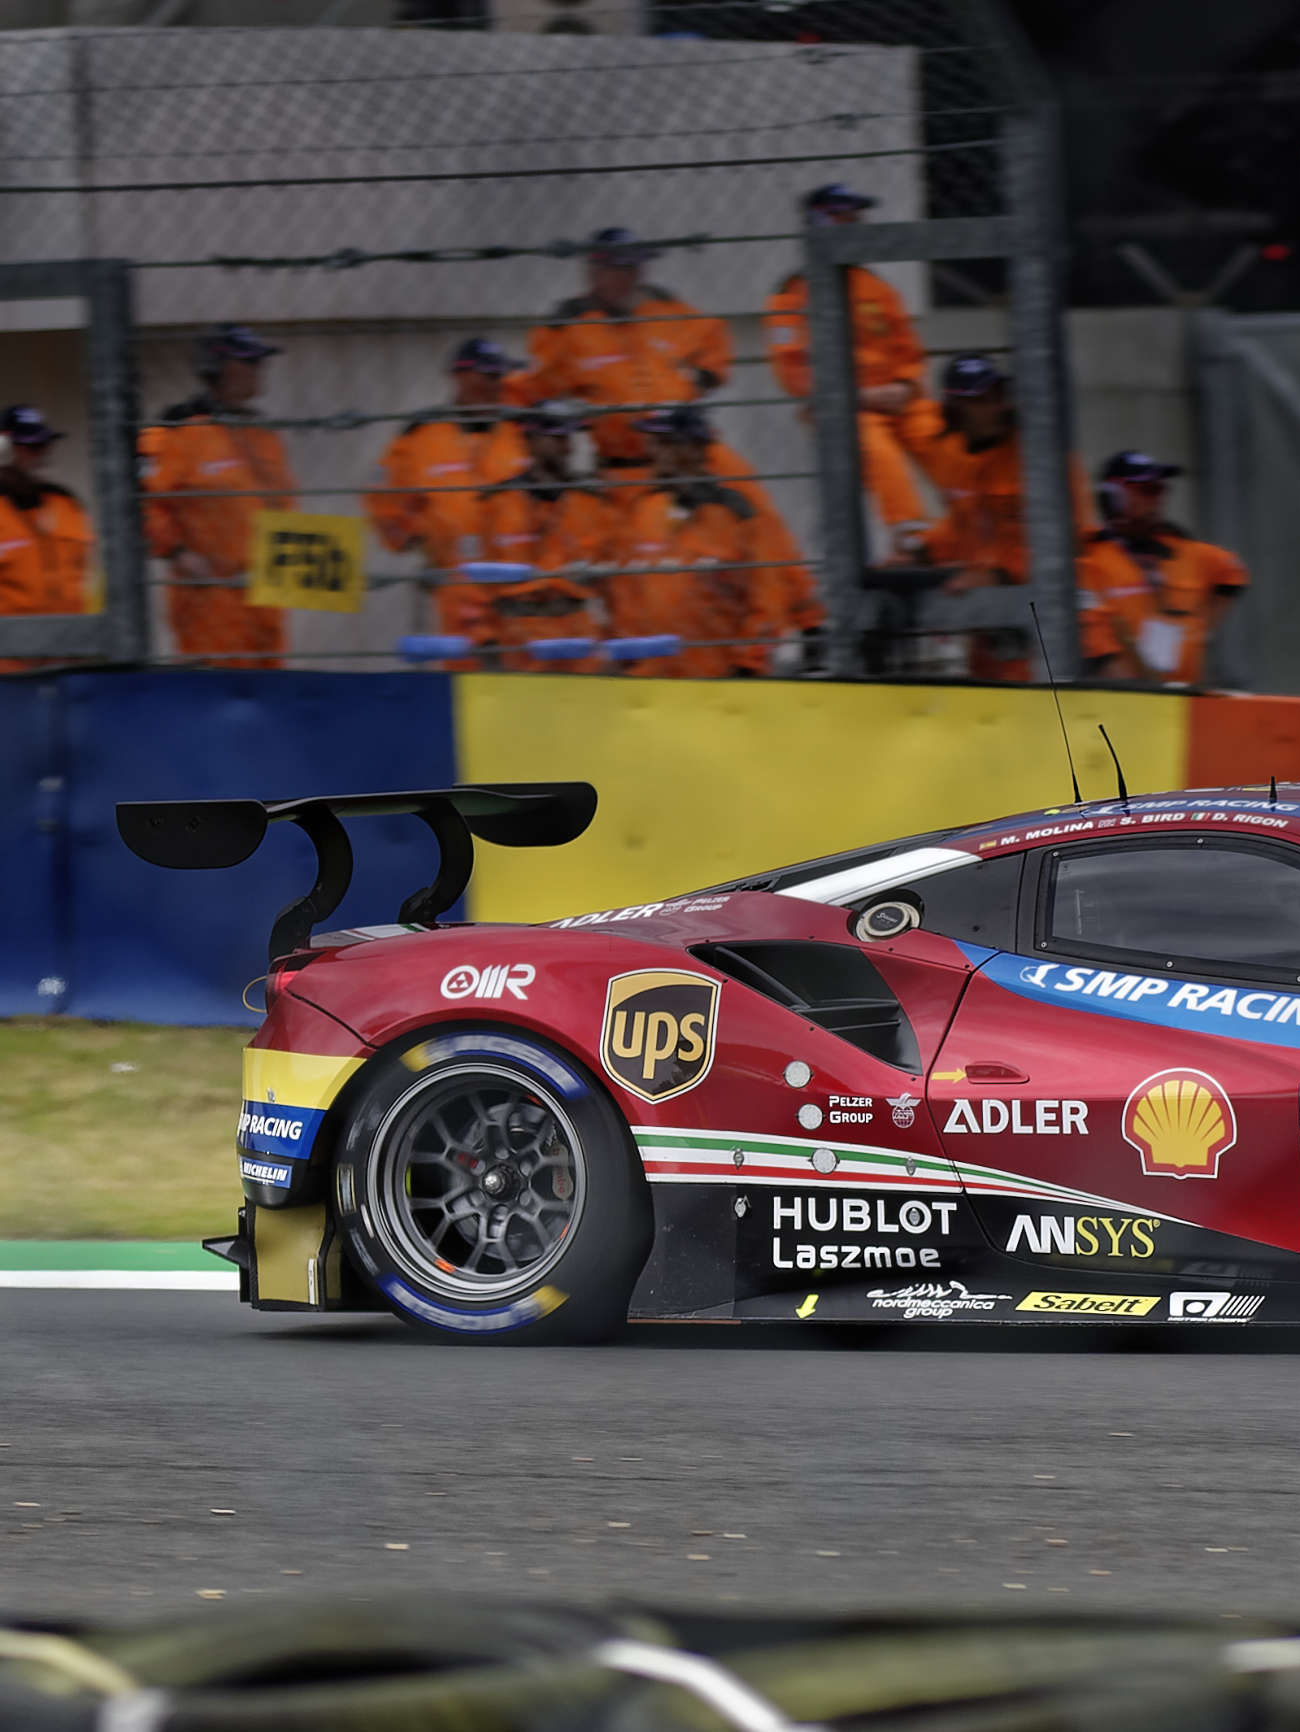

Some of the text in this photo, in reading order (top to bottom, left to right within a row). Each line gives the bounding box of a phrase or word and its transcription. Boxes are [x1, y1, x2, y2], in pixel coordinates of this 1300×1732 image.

[1187, 799, 1300, 812] RACING
[1000, 812, 1289, 846] M. MOLINA S. BIRD D. RIGON
[550, 903, 664, 928] ADLER
[1055, 966, 1169, 1002] SMP
[612, 1011, 705, 1079] ups
[829, 1096, 873, 1107] PELZER
[249, 1114, 303, 1140] RACING
[829, 1111, 873, 1124] GROUP
[943, 1099, 1089, 1134] ADLER
[243, 1161, 288, 1182] MICHELIN
[773, 1197, 957, 1235] HUBLOT
[1006, 1214, 1157, 1258] ANSYS
[773, 1237, 942, 1270] Laszmoe
[872, 1297, 995, 1311] nordmeccanica
[904, 1305, 954, 1319] group
[1033, 1294, 1142, 1314] Sabelt
